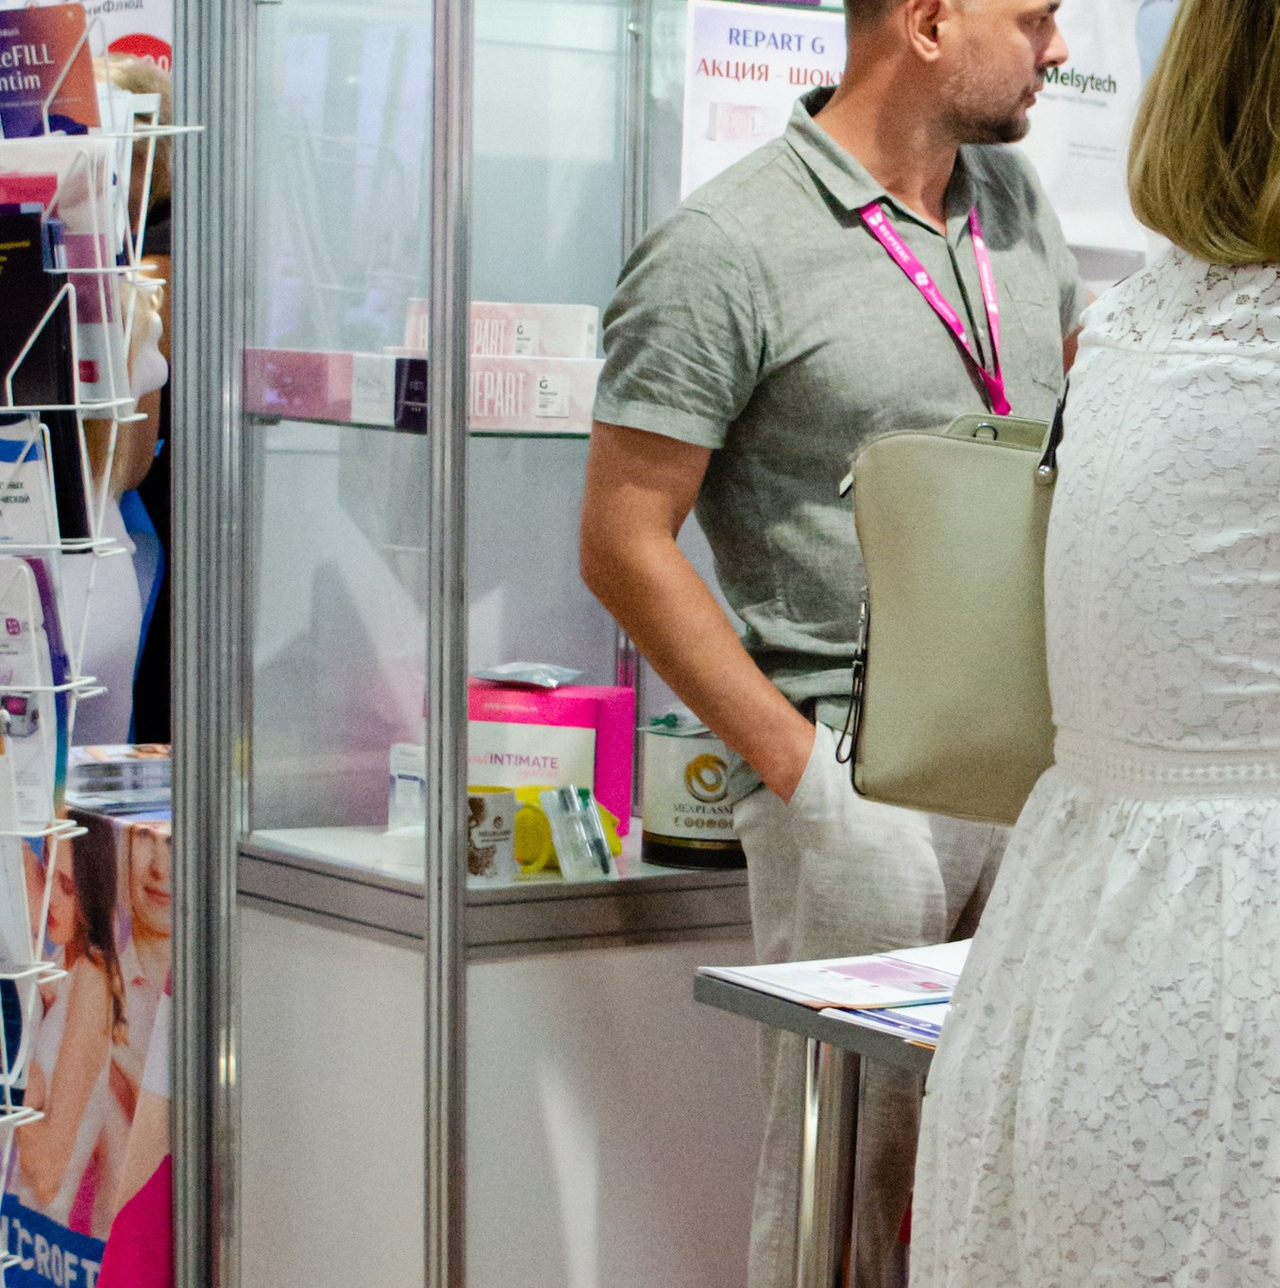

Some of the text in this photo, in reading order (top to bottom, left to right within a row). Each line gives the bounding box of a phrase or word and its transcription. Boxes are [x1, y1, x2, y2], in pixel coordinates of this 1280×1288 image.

[729, 26, 826, 55] REPART G
[697, 57, 769, 83] АКЦИЯ
[1045, 67, 1118, 94] Melsytech
[490, 753, 559, 770] INTIMATE
